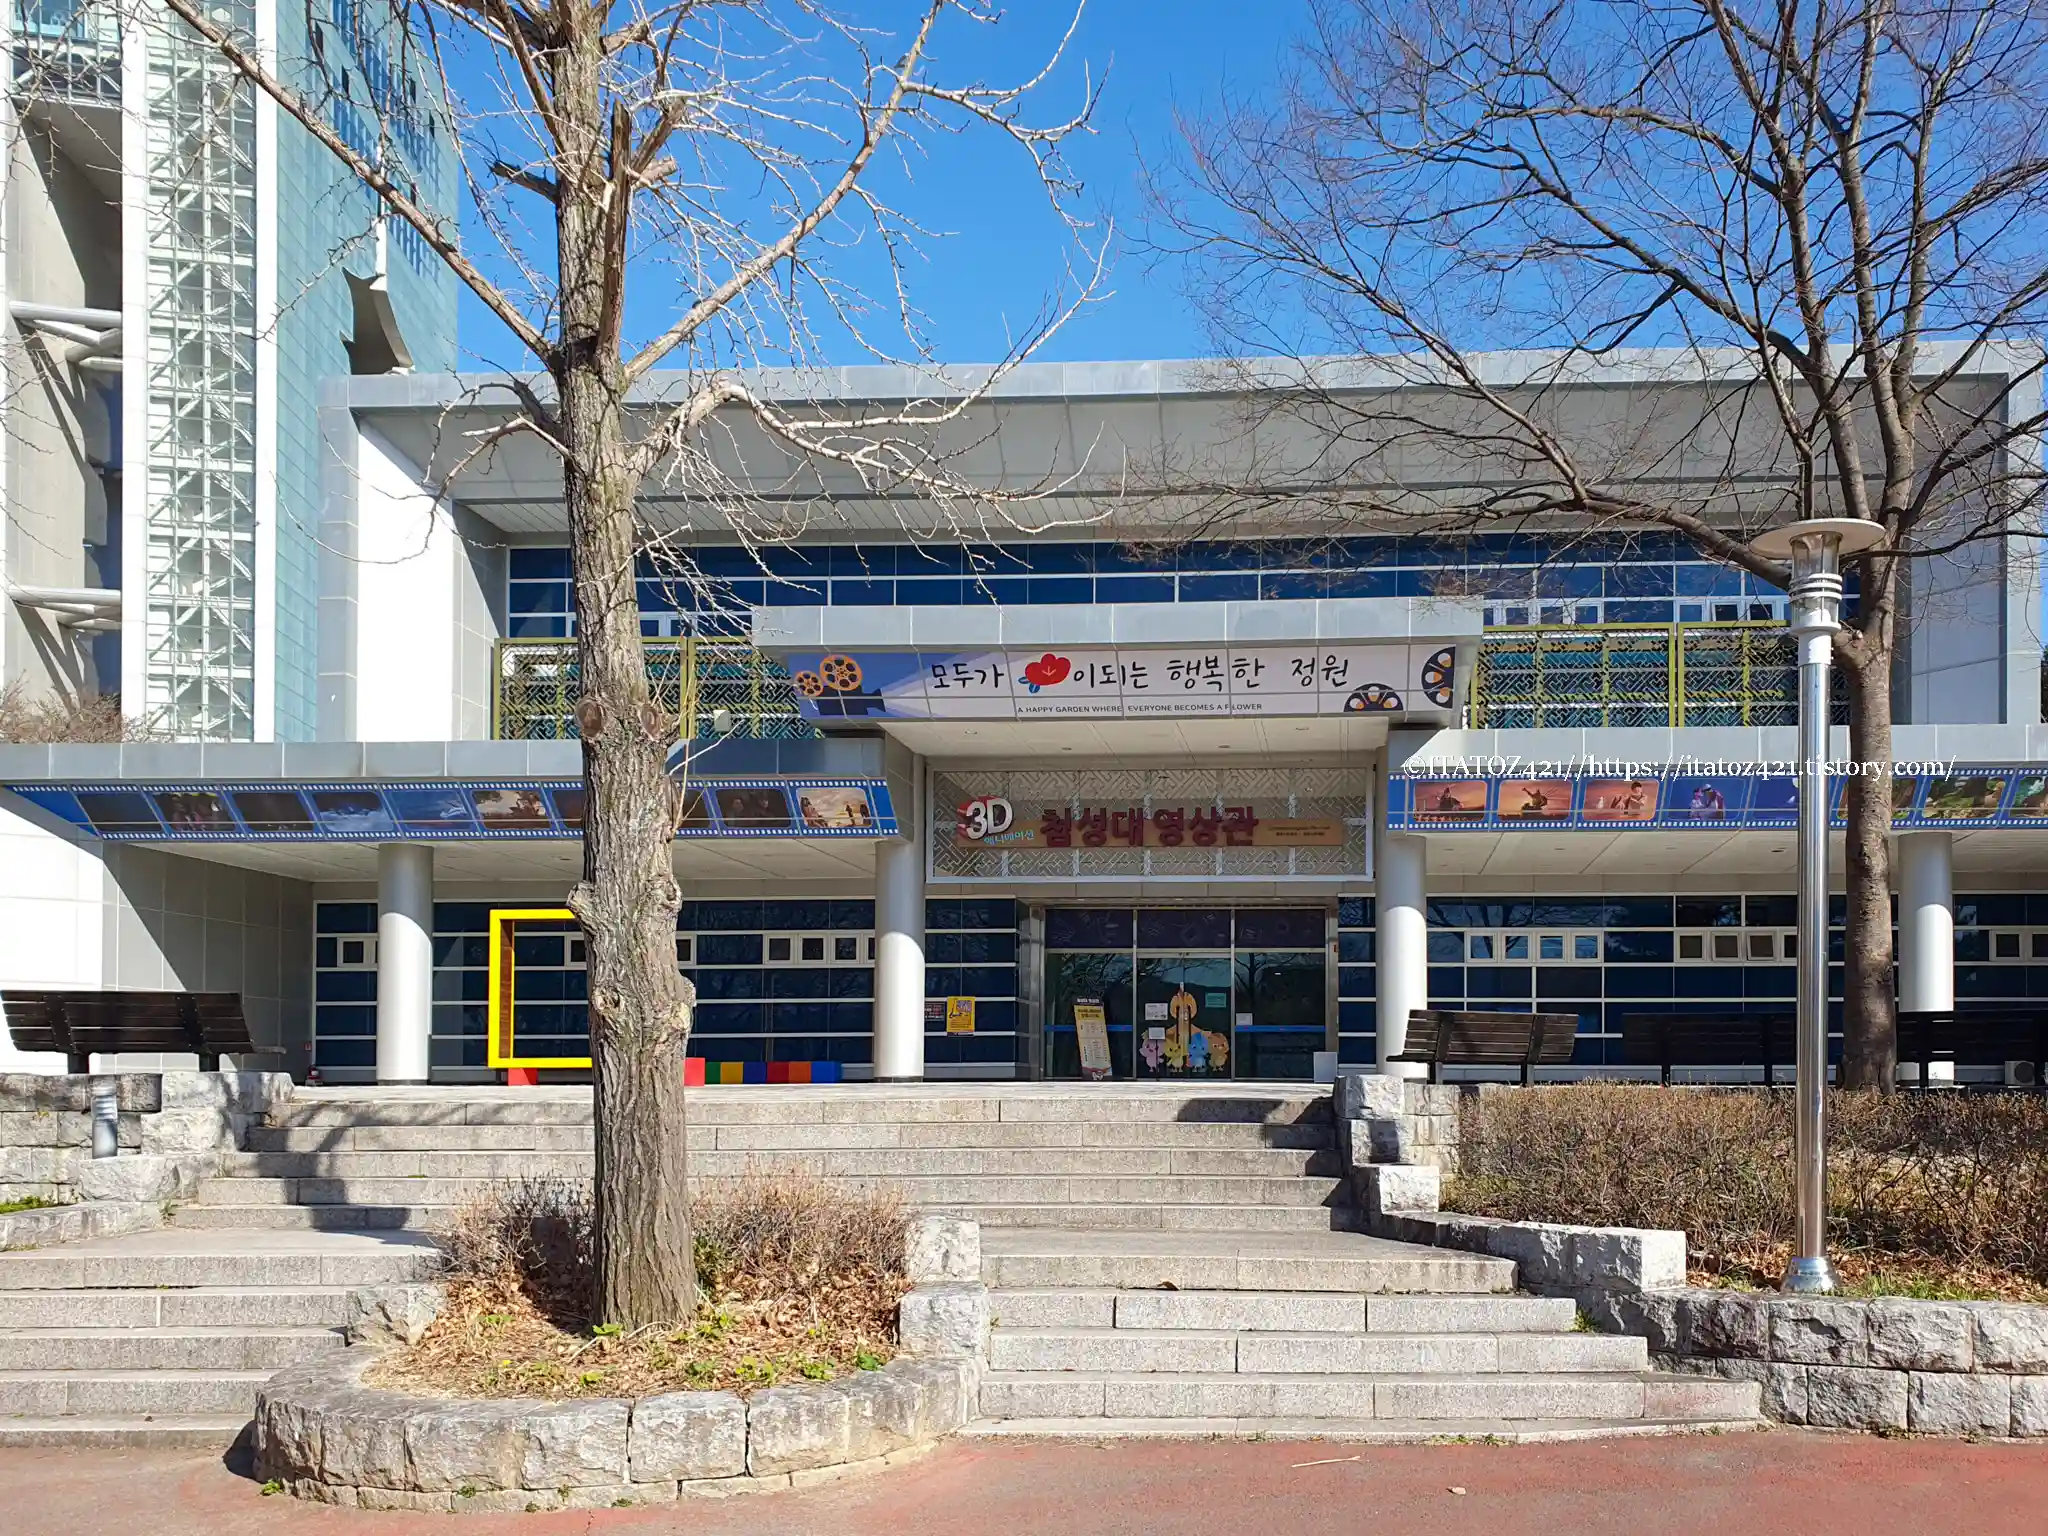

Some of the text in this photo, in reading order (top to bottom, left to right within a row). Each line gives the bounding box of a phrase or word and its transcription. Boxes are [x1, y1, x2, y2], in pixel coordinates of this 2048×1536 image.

[931, 654, 1349, 692] 모두가 이되는 행복한 정원
[1026, 706, 1053, 714] HAPPY
[1092, 705, 1122, 713] WHERE
[1174, 704, 1214, 712] BECOMES
[1224, 703, 1262, 711] FLOWER
[964, 799, 1014, 840] 3D
